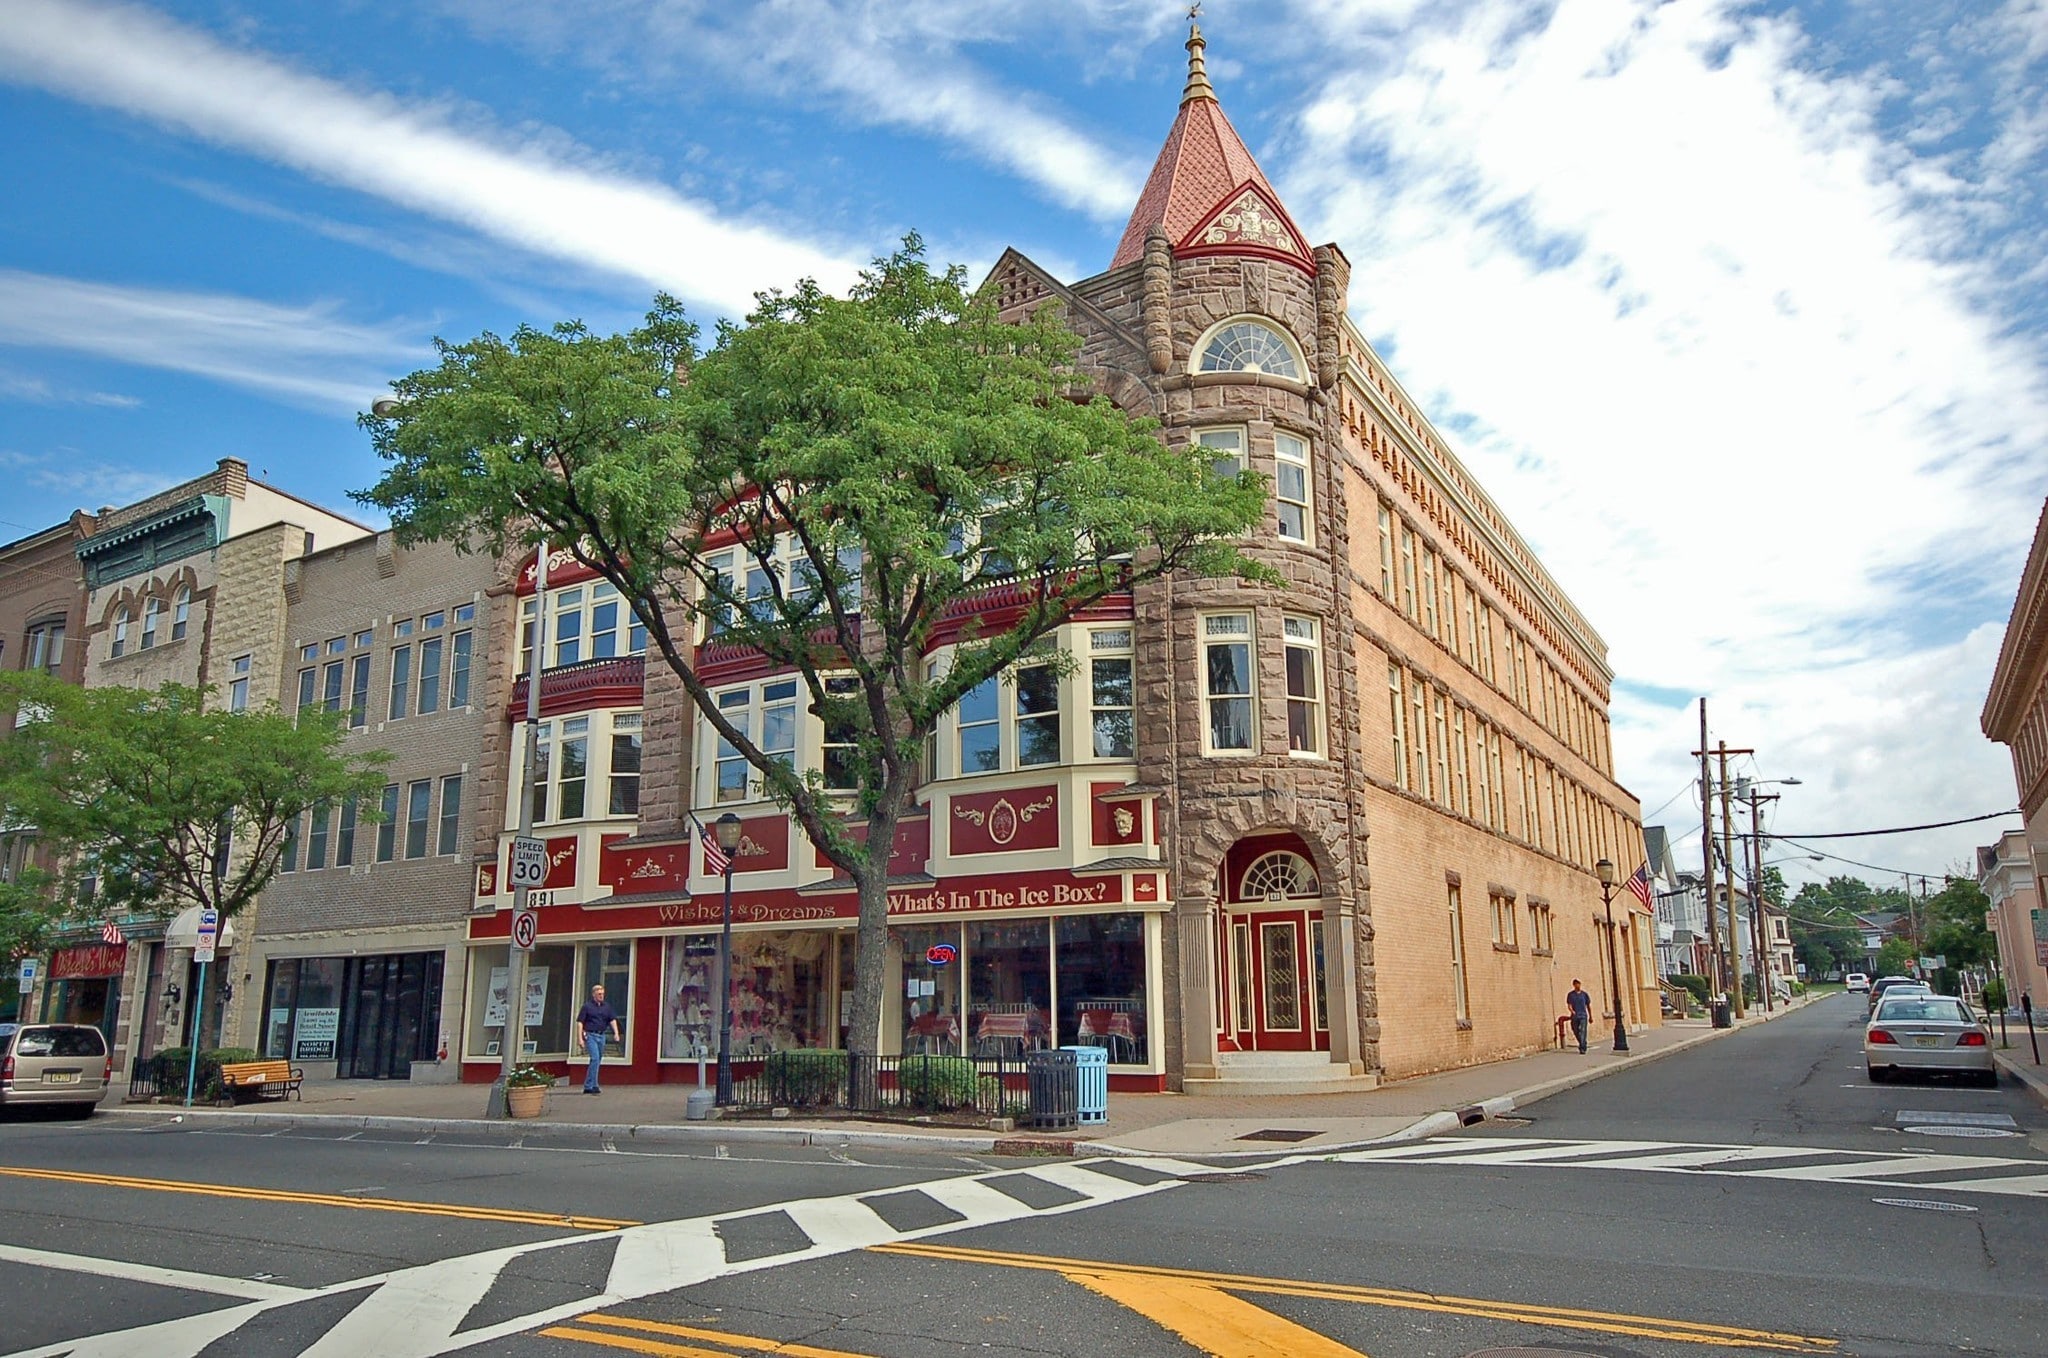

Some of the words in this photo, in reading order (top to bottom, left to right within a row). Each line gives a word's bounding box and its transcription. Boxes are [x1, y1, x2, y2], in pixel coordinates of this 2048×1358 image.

[517, 841, 543, 852] SPEED
[518, 852, 540, 861] LIMIT
[514, 862, 541, 881] 30
[887, 891, 946, 913] What's
[950, 891, 971, 910] In
[975, 889, 1014, 908] The
[1018, 886, 1049, 906] Ice
[1053, 882, 1107, 903] Box?
[737, 904, 749, 915] &
[750, 904, 836, 921] Dreams
[927, 947, 955, 961] OPEN
